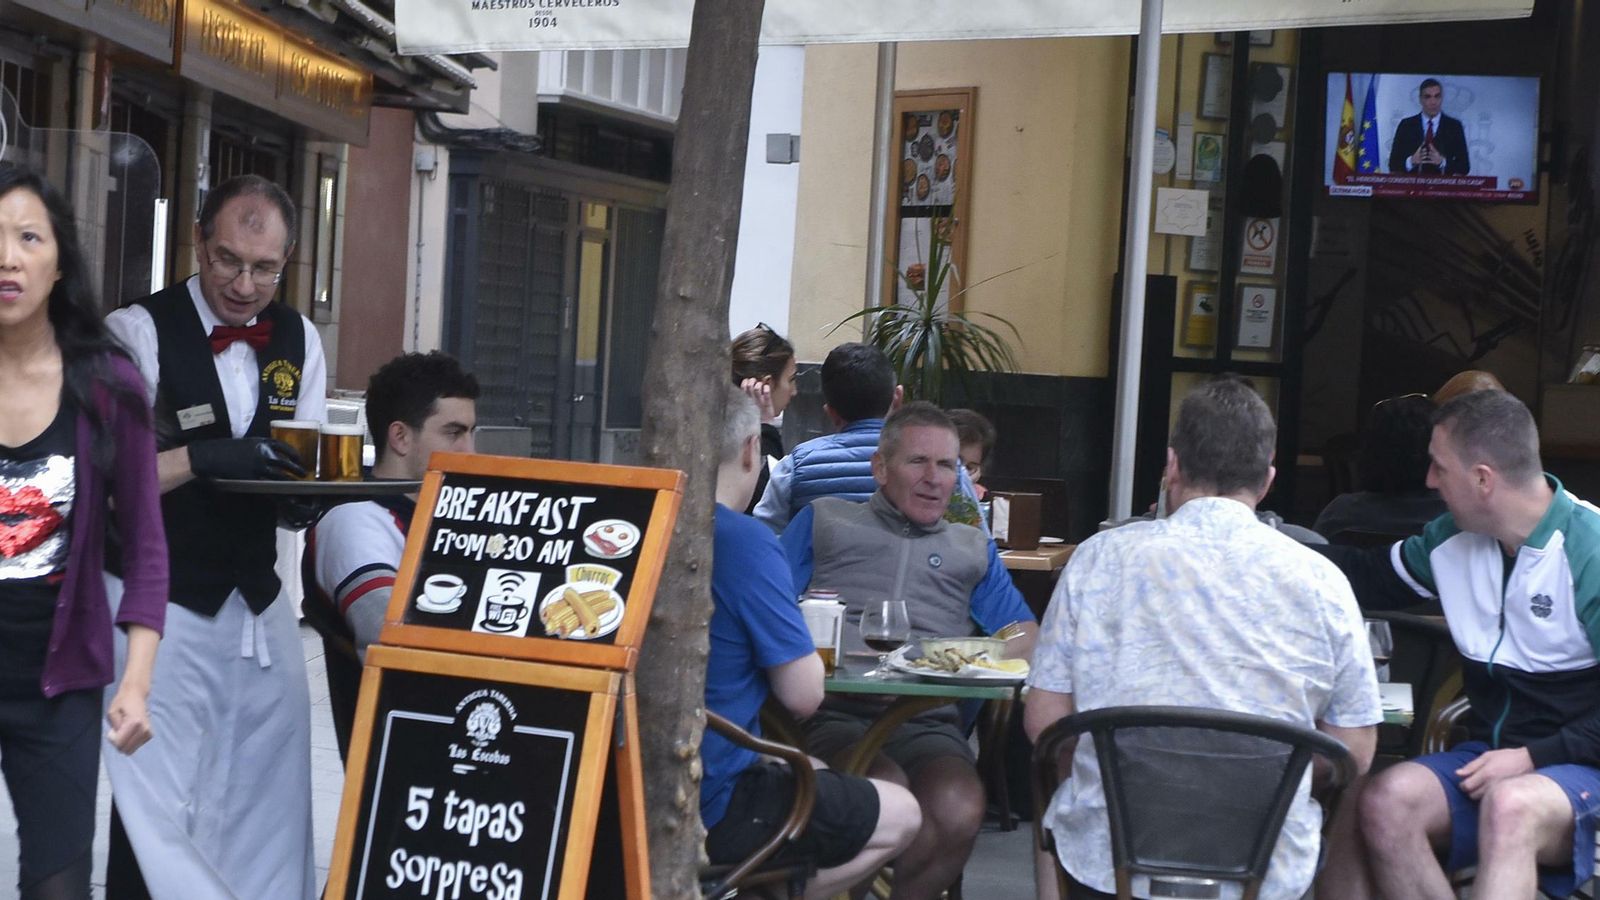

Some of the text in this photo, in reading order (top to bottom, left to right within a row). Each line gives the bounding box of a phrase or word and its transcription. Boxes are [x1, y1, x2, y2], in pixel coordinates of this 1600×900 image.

[471, 0, 620, 10] MAESTROS CERVECEROS
[529, 17, 558, 28] 1904
[433, 485, 597, 536] BREAKFAST
[536, 539, 575, 566] AM
[471, 747, 511, 766] Escobas
[404, 786, 526, 847] 5 tapas
